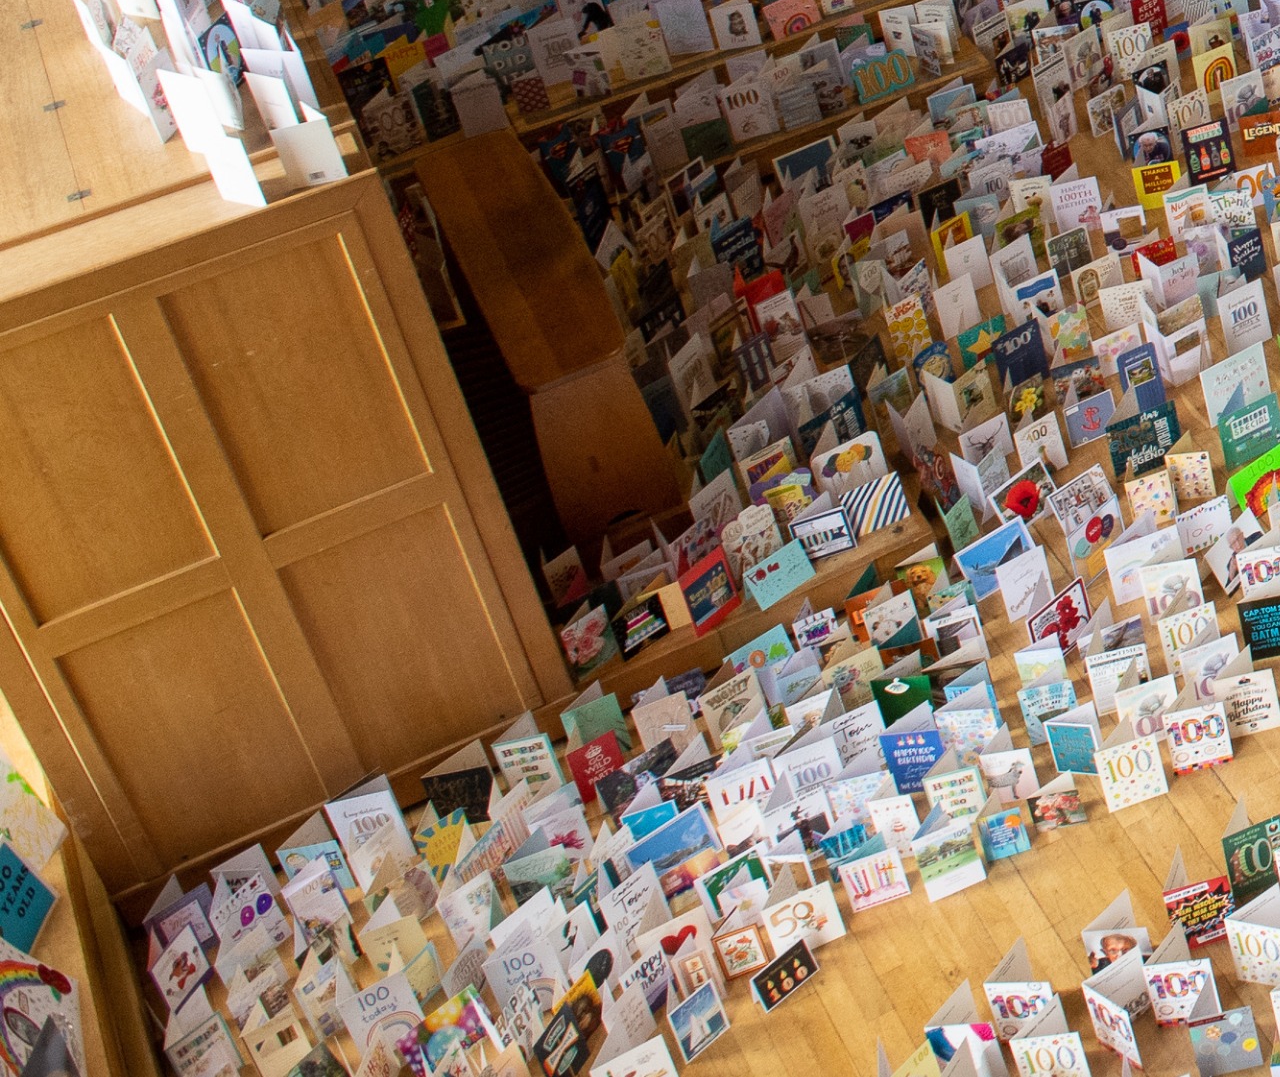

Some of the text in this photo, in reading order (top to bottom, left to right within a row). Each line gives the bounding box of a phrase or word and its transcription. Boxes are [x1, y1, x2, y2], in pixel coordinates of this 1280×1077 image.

[1117, 32, 1148, 58] 100
[856, 54, 913, 97] 100
[726, 88, 761, 113] 100
[1142, 167, 1171, 177] THANKS
[1145, 178, 1172, 190] MILLION
[1058, 189, 1094, 203] 100TH
[1213, 197, 1251, 210] Thank
[1223, 211, 1247, 226] You
[1230, 300, 1259, 325] 100
[1026, 424, 1048, 444] 100
[1228, 703, 1273, 721] Birthday
[1231, 696, 1264, 710] Happy
[1168, 714, 1227, 747] 100
[585, 757, 612, 774] WILD
[588, 753, 604, 765] GO
[1105, 749, 1153, 784] 100
[793, 765, 833, 787] 100
[349, 813, 390, 835] 100
[1231, 837, 1275, 886] 100
[1, 867, 29, 914] YEARS
[17, 886, 37, 918] OLD
[1234, 930, 1280, 962] 100
[504, 950, 536, 972] 100
[359, 985, 390, 1010] 100
[1086, 996, 1133, 1044] 100
[1022, 1046, 1076, 1077] 100
